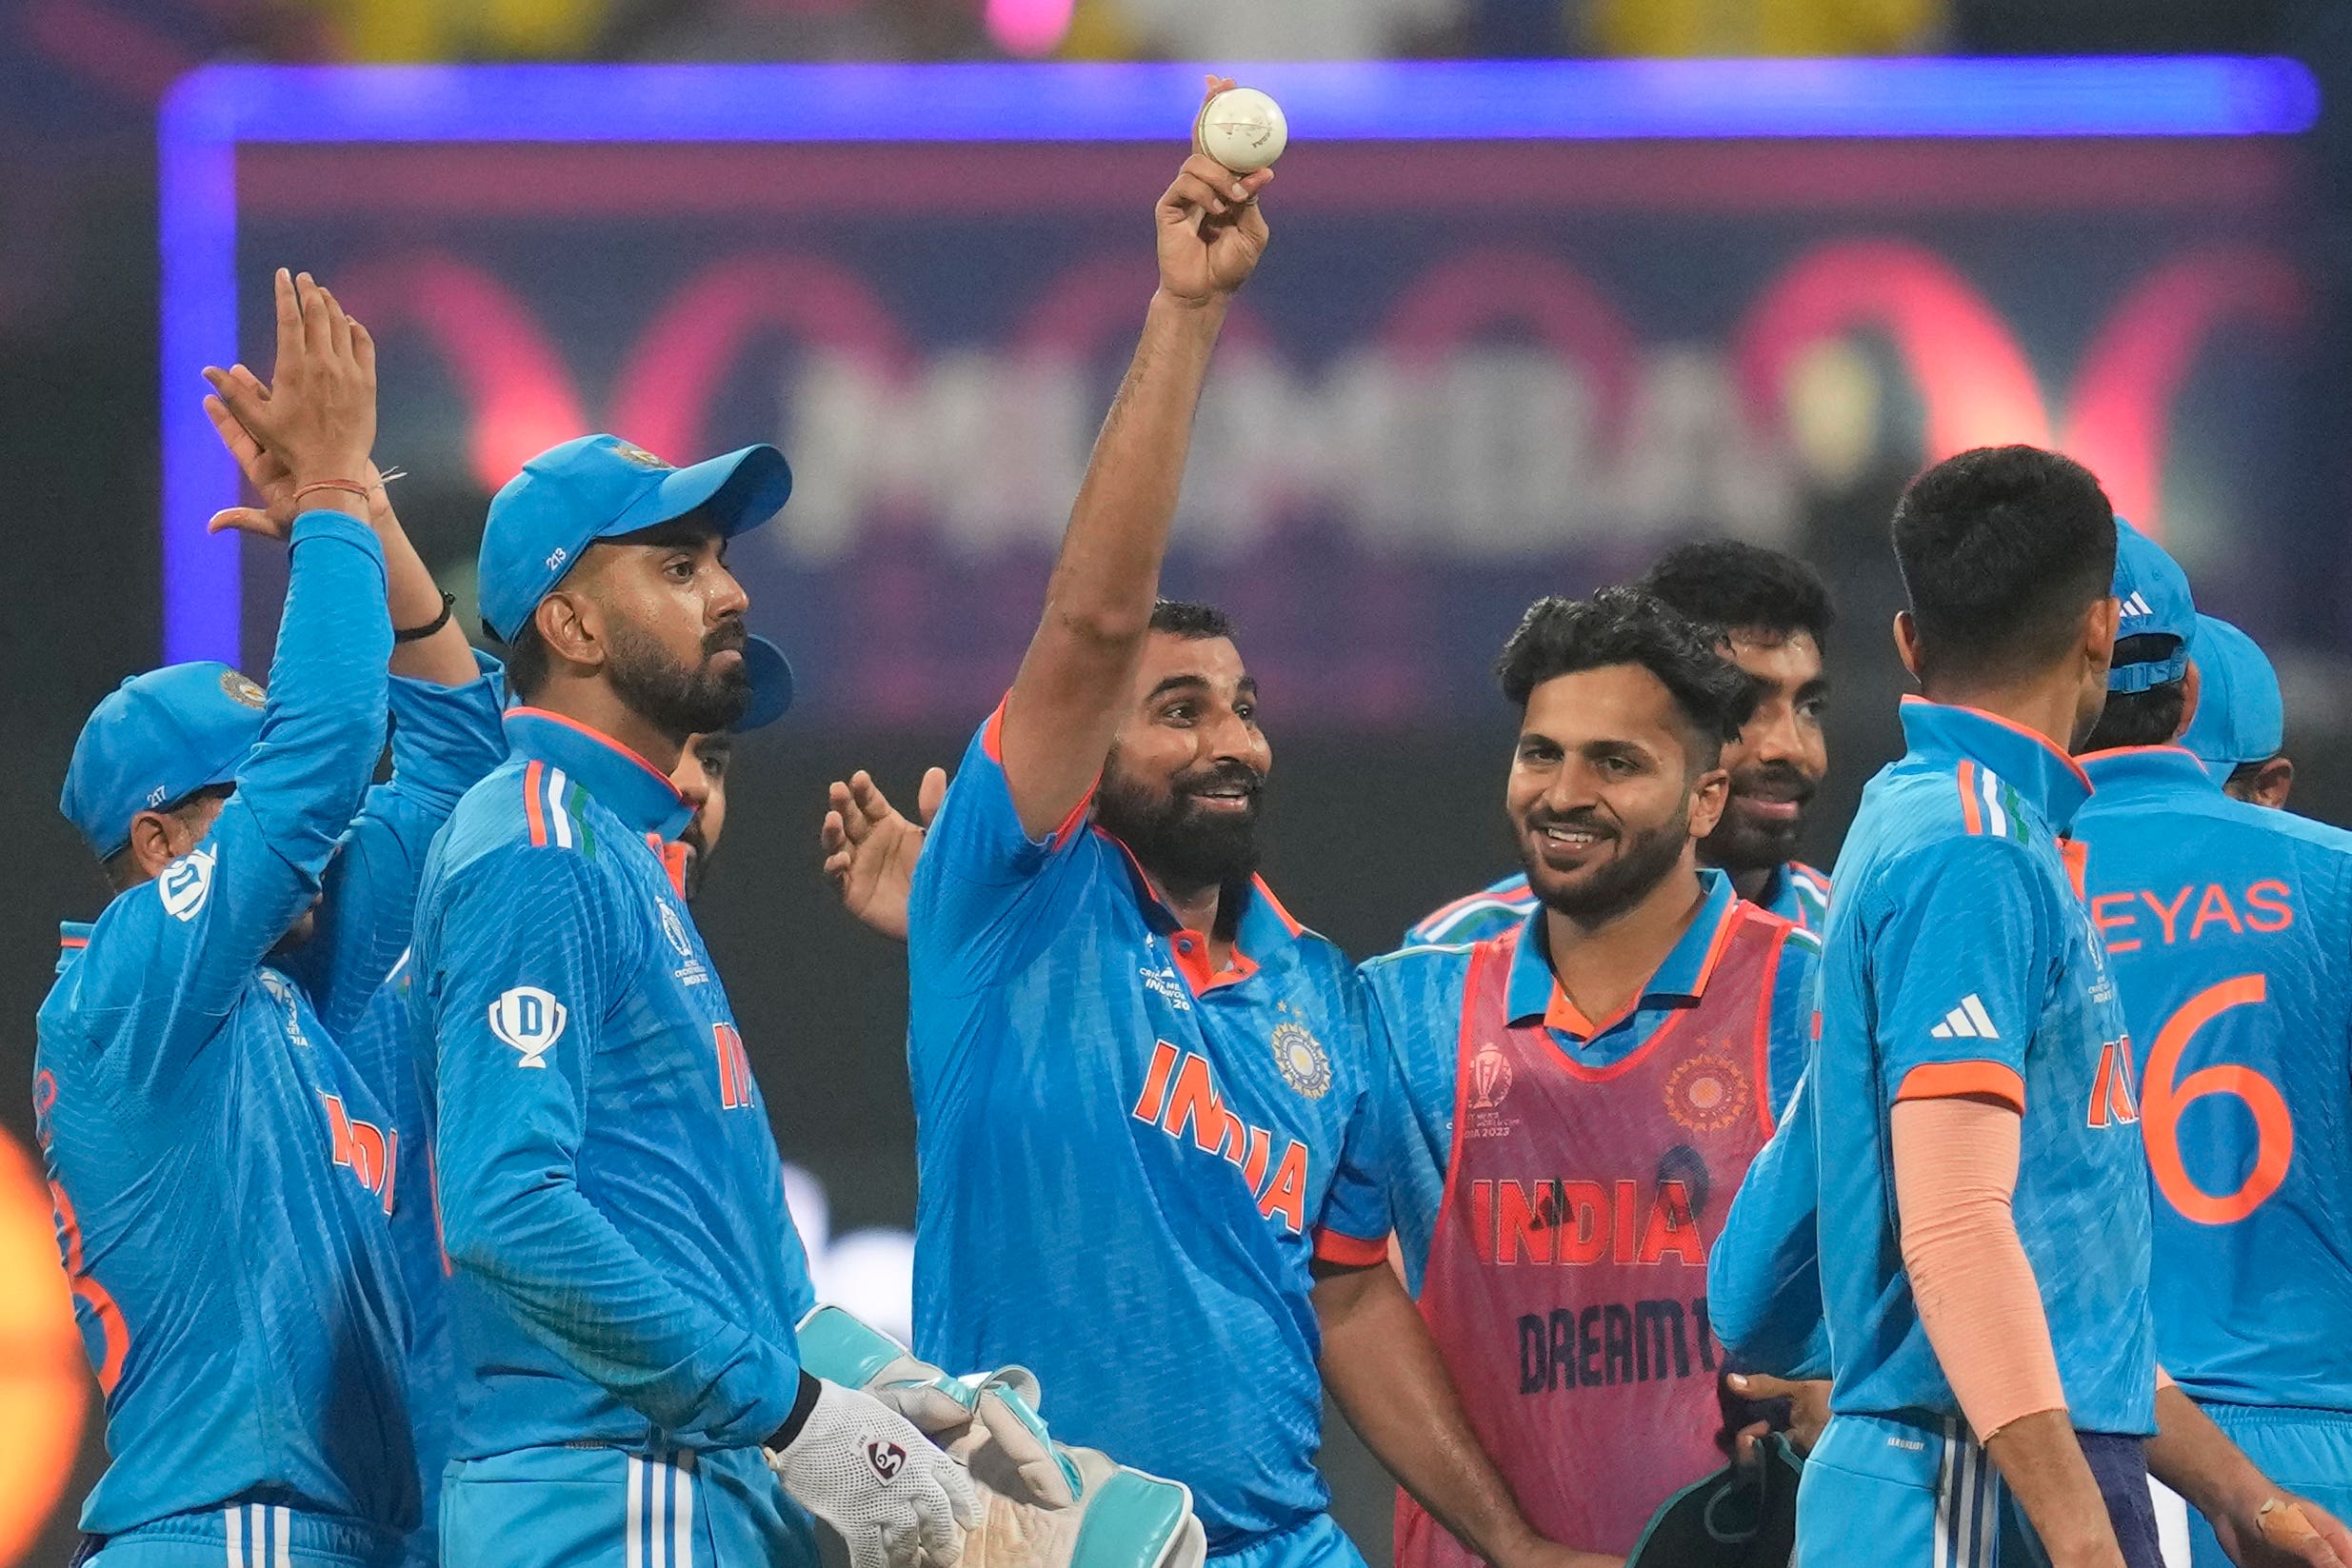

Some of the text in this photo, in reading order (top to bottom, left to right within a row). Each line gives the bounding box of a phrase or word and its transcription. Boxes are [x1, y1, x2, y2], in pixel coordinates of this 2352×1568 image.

[546, 547, 567, 571] 213
[147, 785, 166, 807] 217
[2141, 973, 2294, 1225] 6
[1482, 1126, 1510, 1138] 2023
[1472, 1179, 1706, 1266] INDIA
